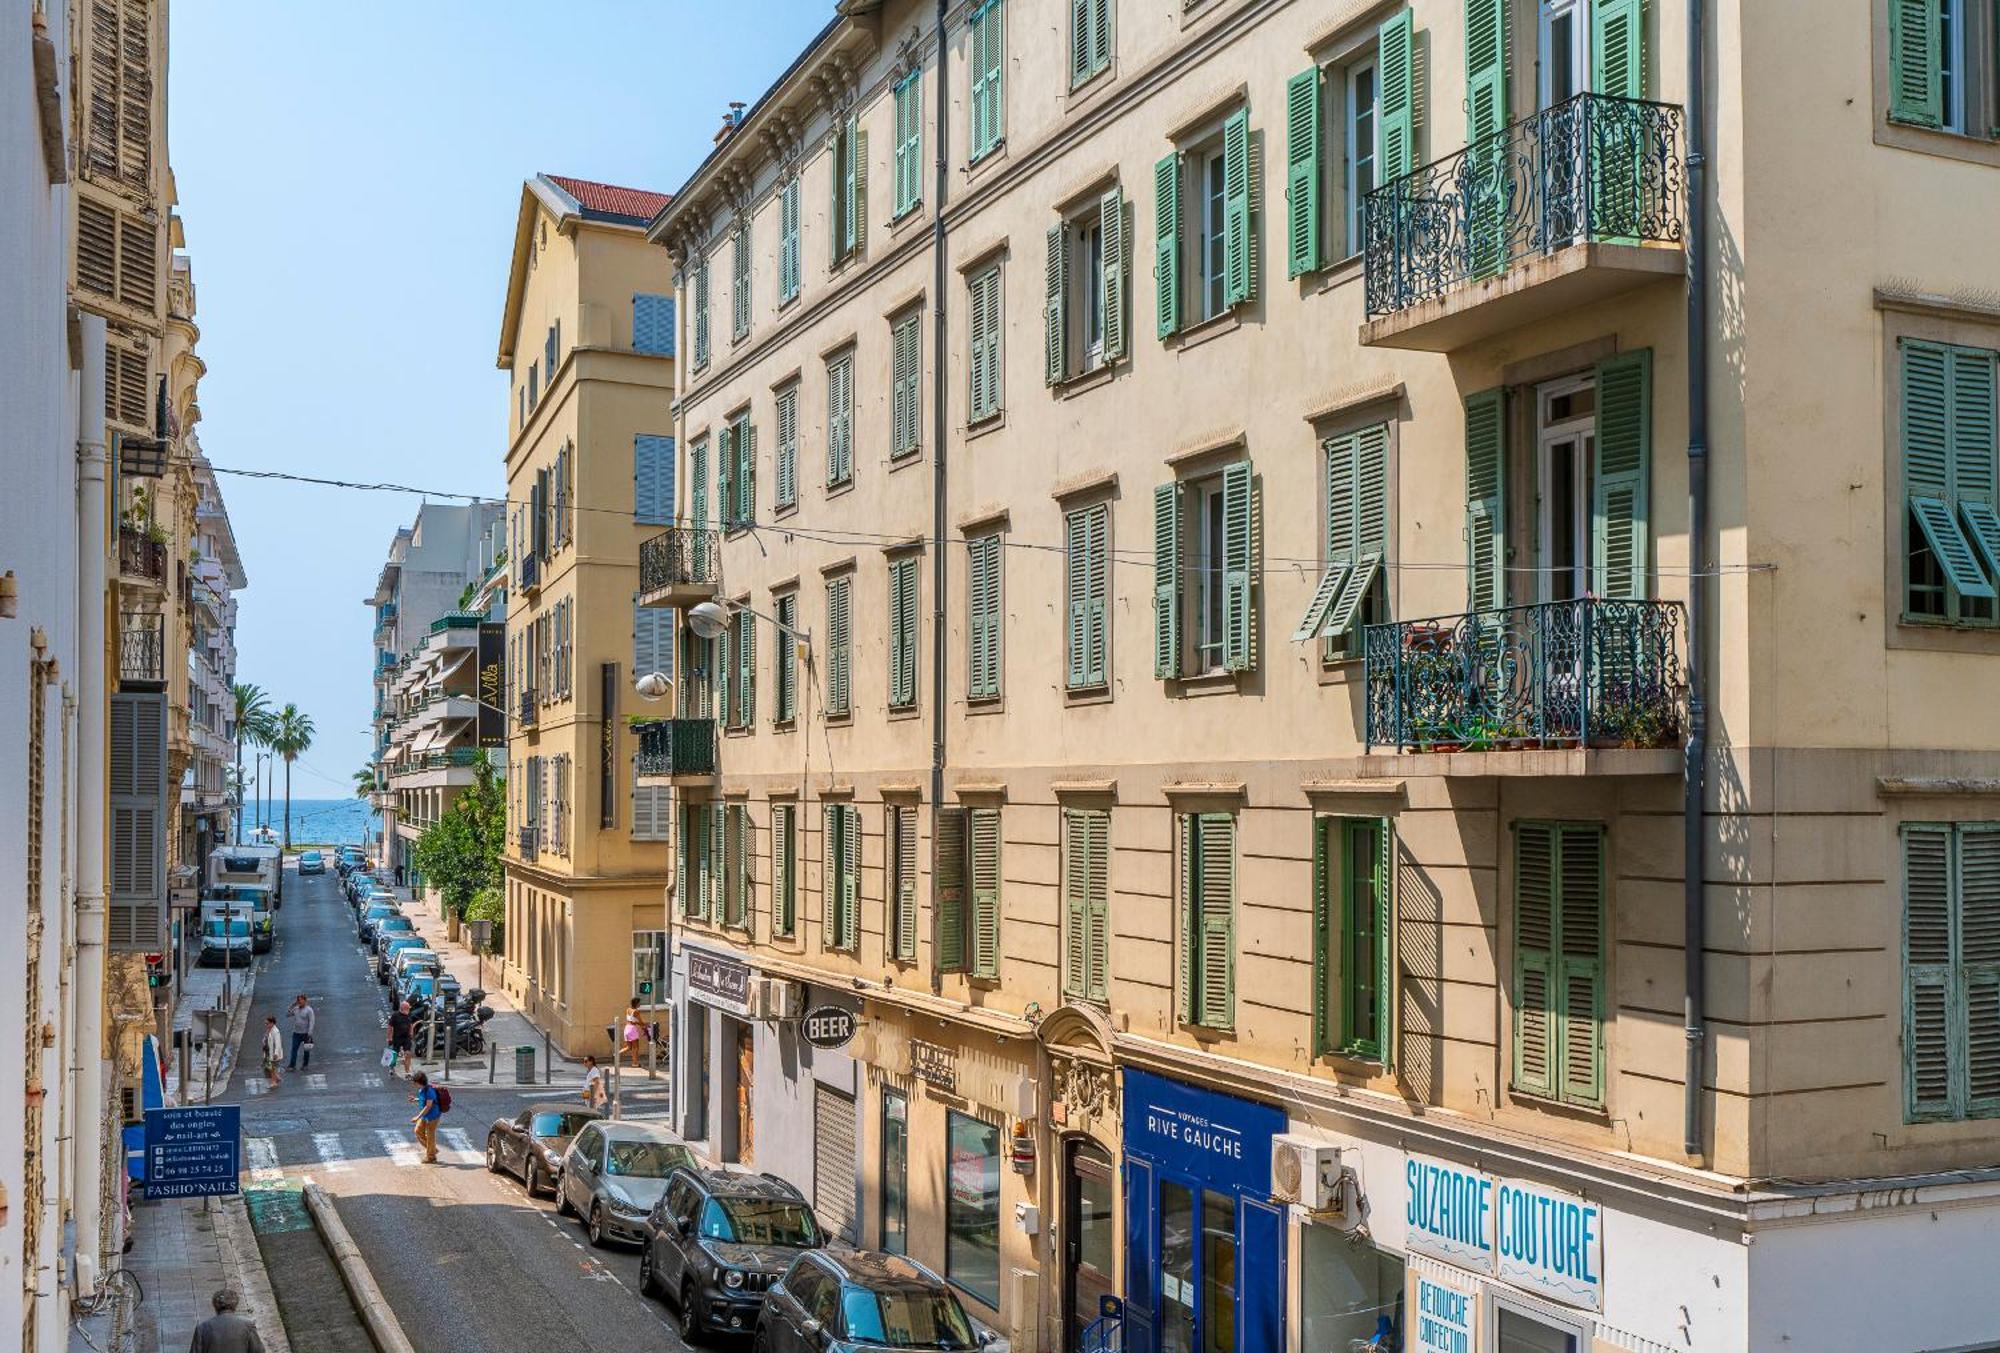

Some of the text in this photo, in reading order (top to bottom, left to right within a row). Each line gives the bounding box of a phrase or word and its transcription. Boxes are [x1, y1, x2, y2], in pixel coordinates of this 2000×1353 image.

[481, 663, 498, 699] Villa
[809, 1016, 849, 1039] BEER
[170, 1120, 216, 1130] des ongles
[184, 1110, 192, 1118] et
[1178, 1111, 1209, 1127] VOYAGES
[176, 1131, 209, 1140] nail-art
[1148, 1115, 1242, 1159] RIVE GAUCHE
[1407, 1160, 1598, 1284] SUZANNE COUTURE
[1420, 1280, 1469, 1328] RETOUCHE
[1419, 1315, 1468, 1353] CONFECTION
